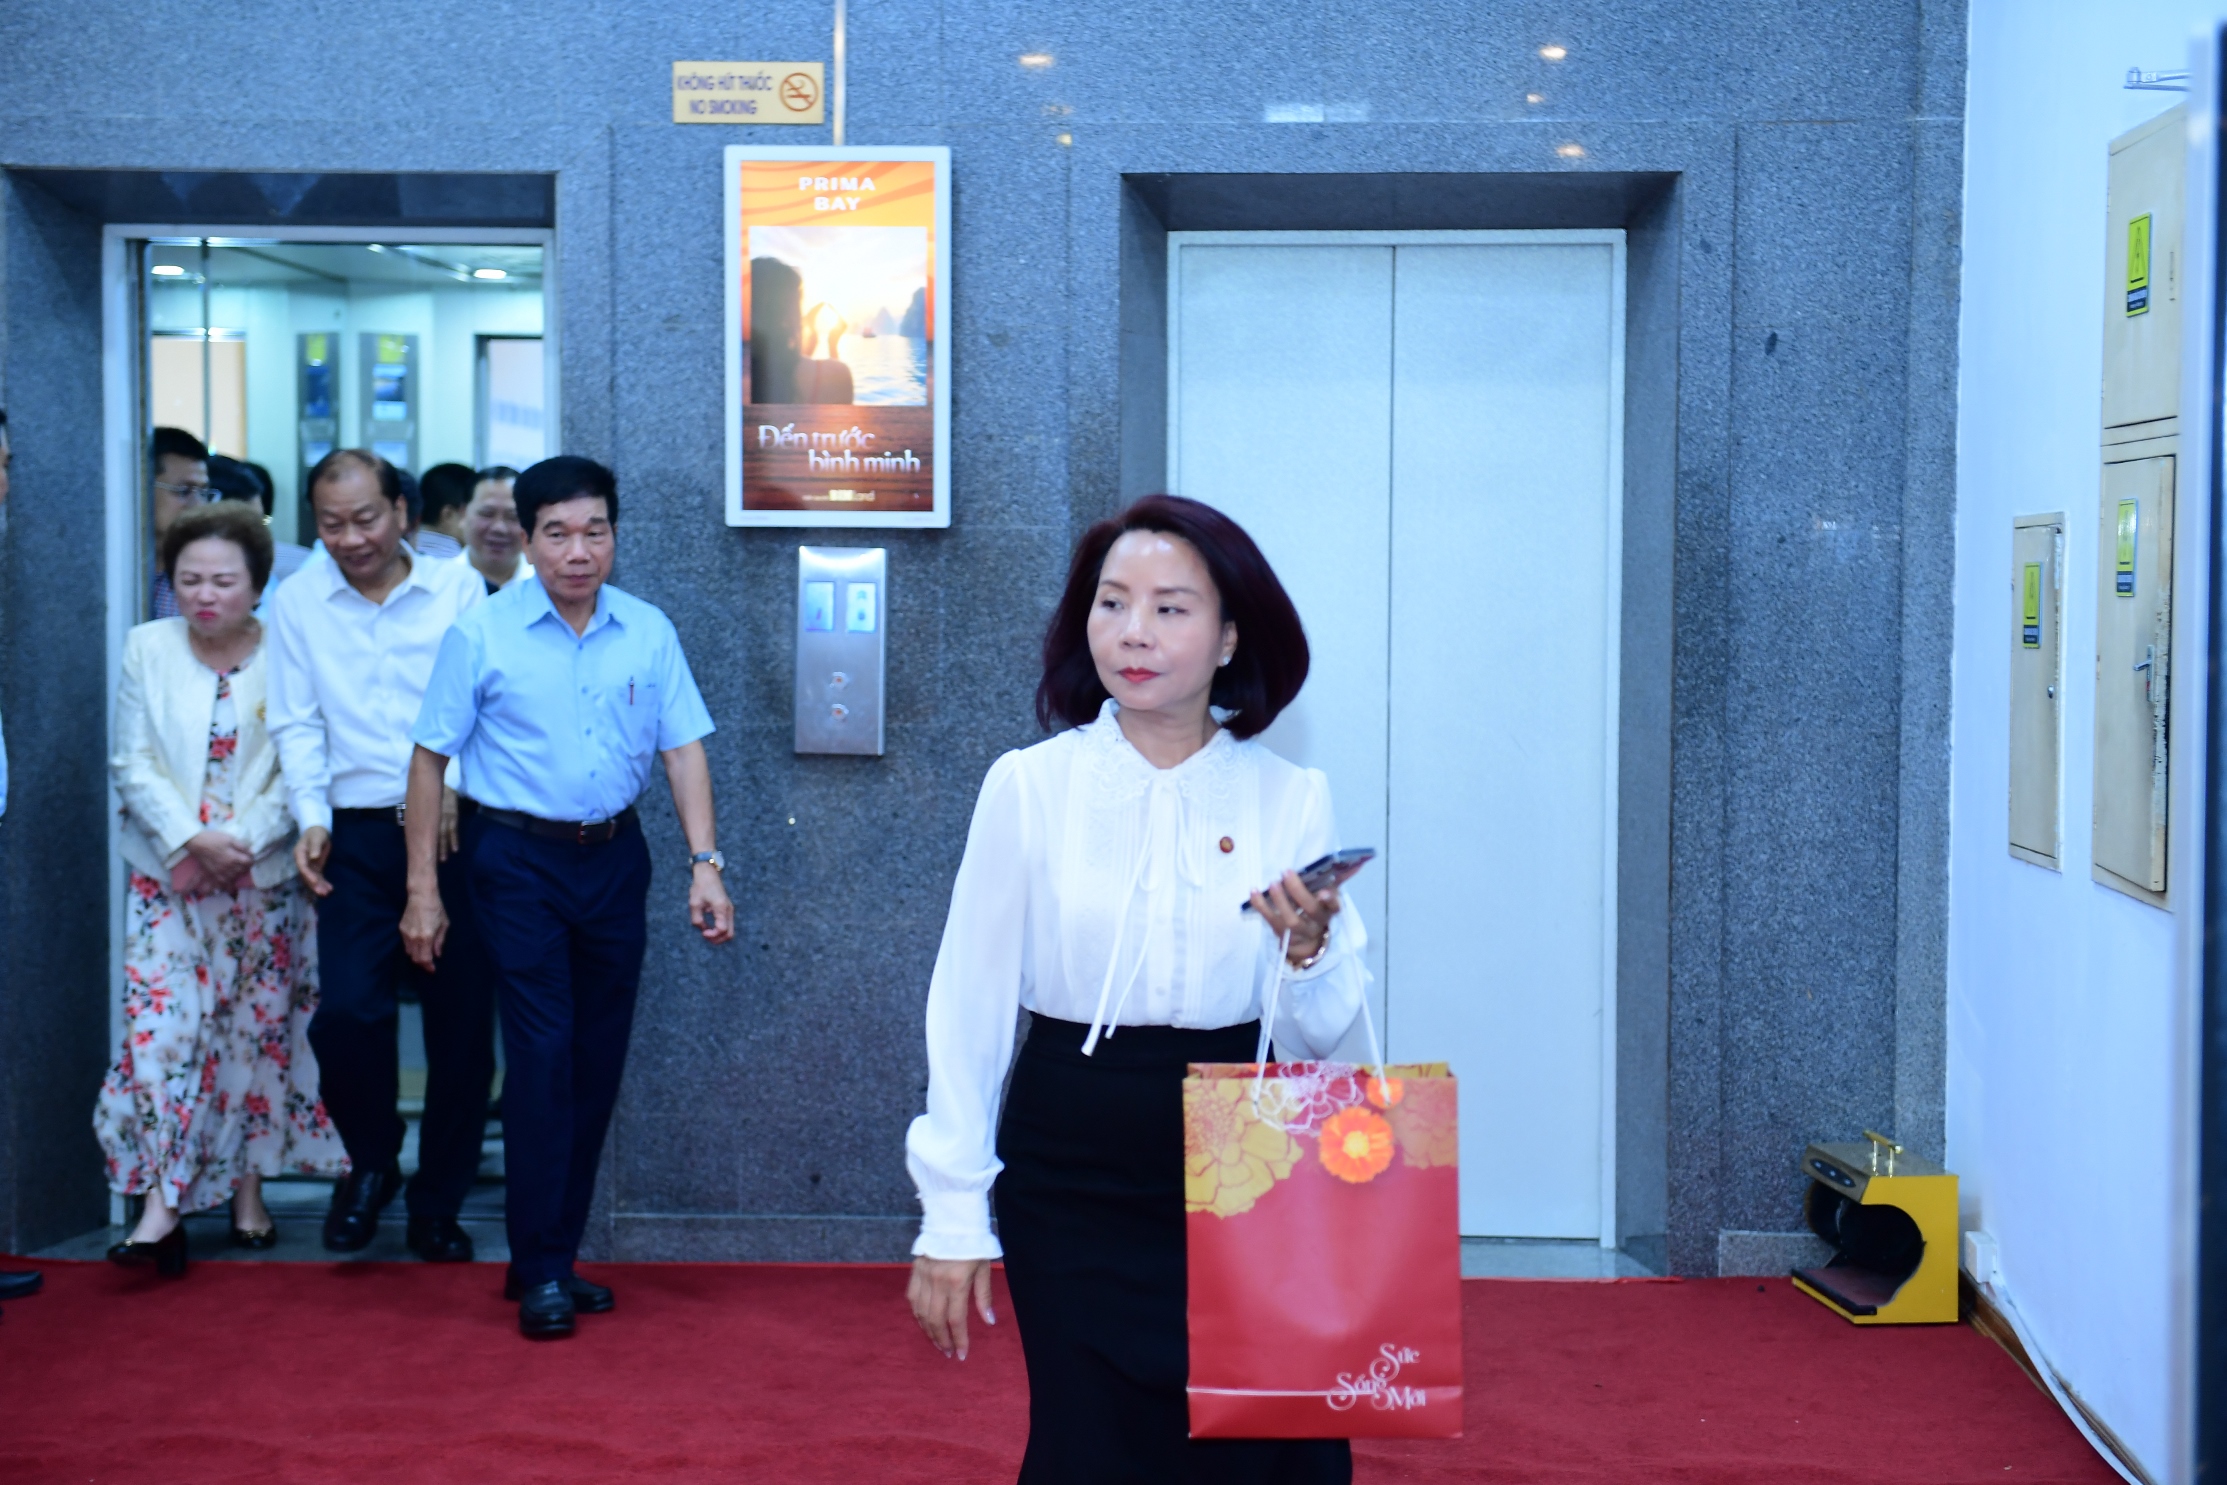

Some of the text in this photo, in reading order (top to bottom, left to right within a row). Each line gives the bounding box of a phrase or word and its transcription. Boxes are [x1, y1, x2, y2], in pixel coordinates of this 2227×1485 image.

[689, 99, 758, 115] NO SMOKING
[798, 176, 876, 191] PRIMA
[813, 196, 861, 211] BAY
[757, 423, 876, 449] Đến trước
[808, 449, 921, 473] bình minh
